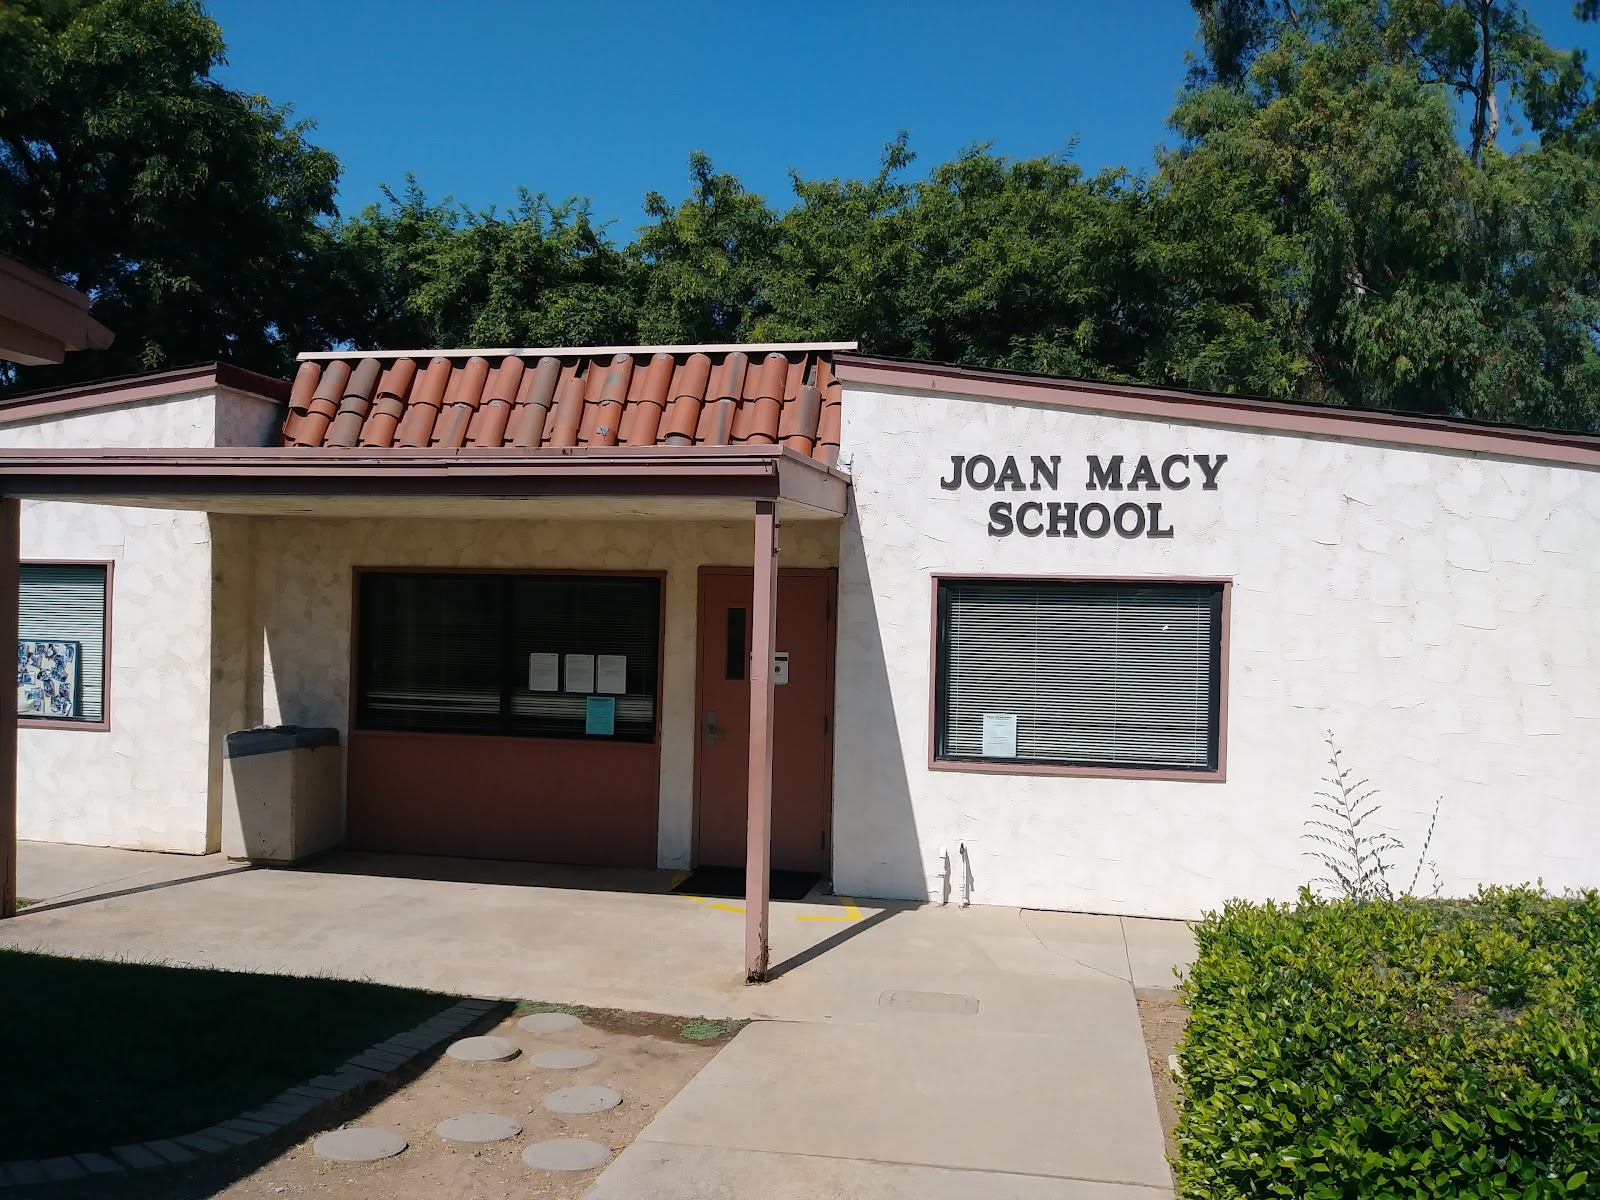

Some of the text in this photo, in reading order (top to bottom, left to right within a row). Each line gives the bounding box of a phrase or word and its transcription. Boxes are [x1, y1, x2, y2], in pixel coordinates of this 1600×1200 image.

[940, 454, 1228, 491] JOAN MACY
[988, 501, 1174, 539] SCHOOL
